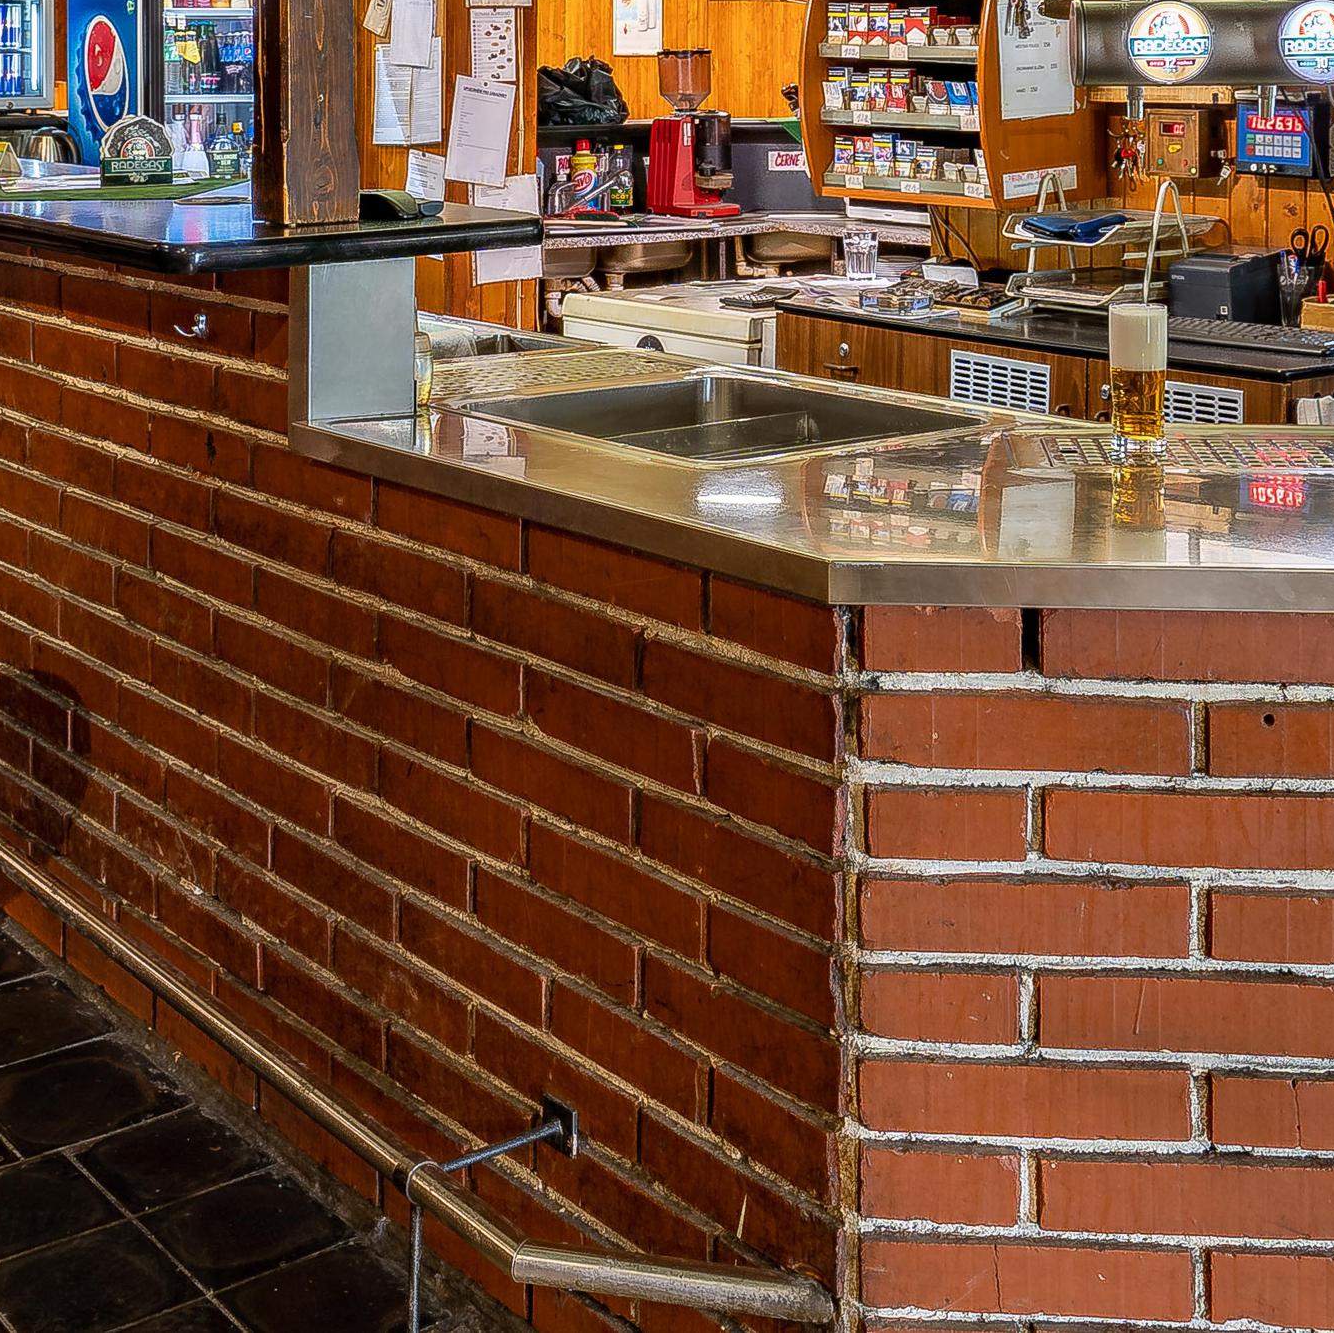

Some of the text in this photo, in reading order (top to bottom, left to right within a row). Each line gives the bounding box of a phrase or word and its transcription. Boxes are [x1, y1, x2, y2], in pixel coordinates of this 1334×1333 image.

[1133, 39, 1209, 57] RADEGAST
[1166, 57, 1176, 68] 12
[1316, 56, 1328, 69] 10
[111, 158, 169, 173] RADEGAST
